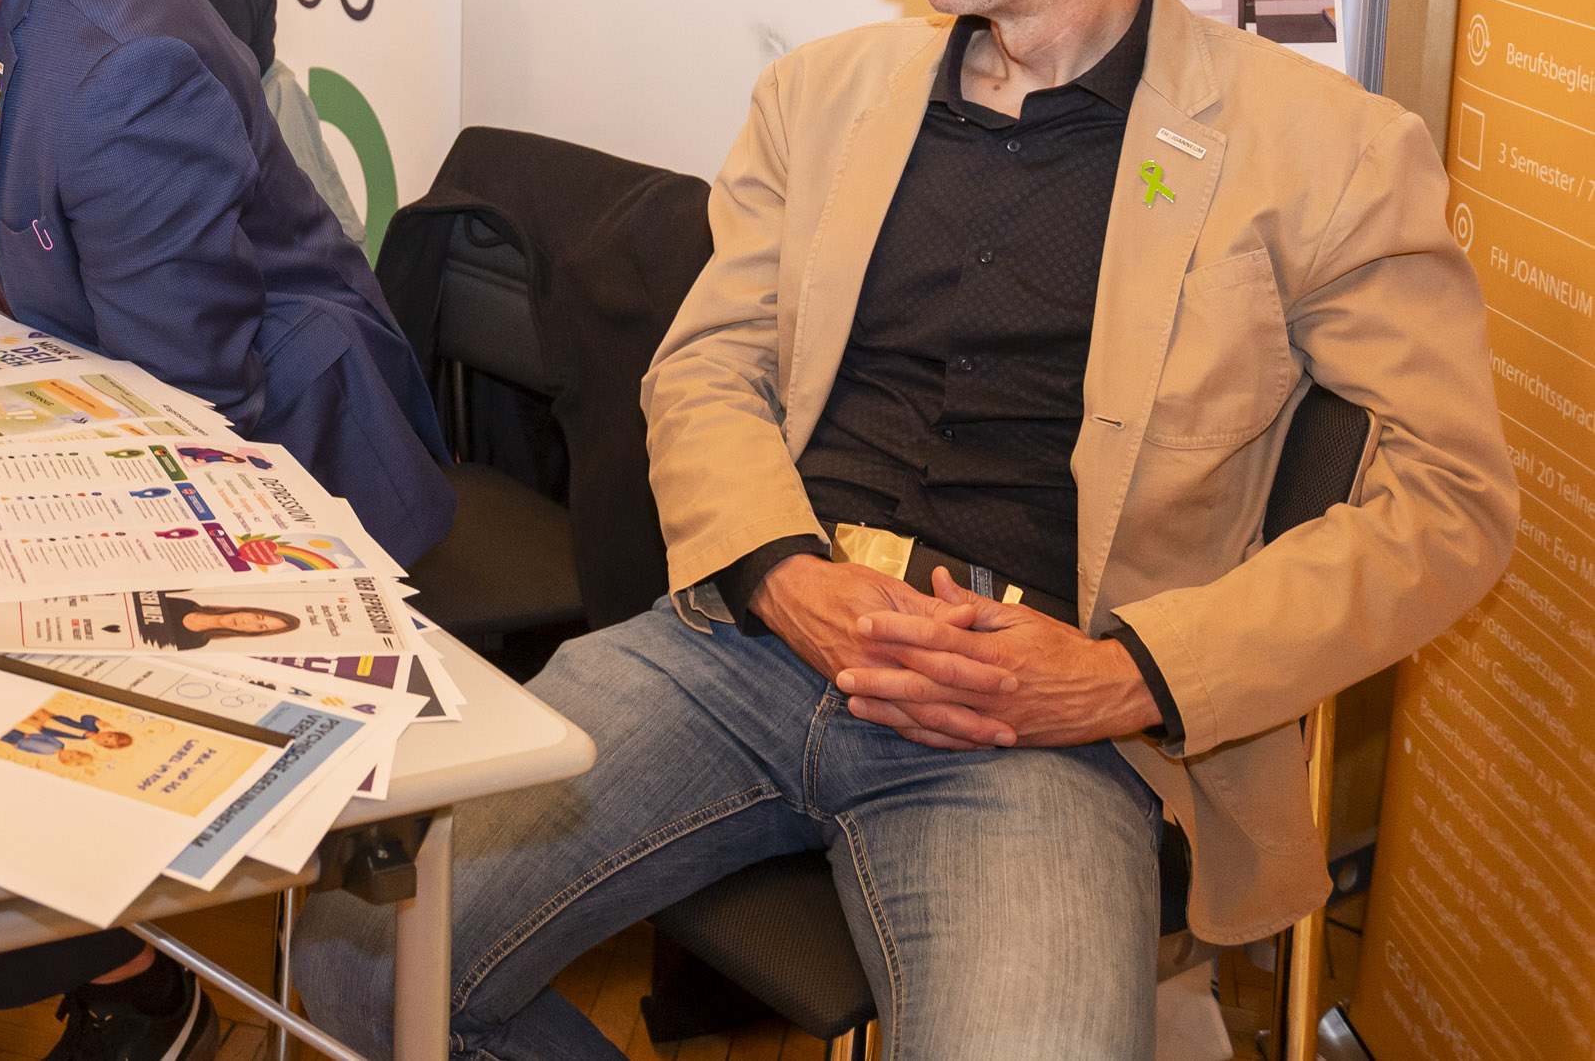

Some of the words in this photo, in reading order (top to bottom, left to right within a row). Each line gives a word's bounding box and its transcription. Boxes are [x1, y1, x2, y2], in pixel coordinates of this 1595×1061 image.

[1498, 141, 1507, 165] 3
[1508, 146, 1575, 195] Semester
[1489, 244, 1509, 275] FH
[1510, 256, 1593, 320] JOANNEUM
[257, 475, 315, 525] DEPRESSION
[1536, 460, 1555, 490] 20
[1553, 536, 1577, 573] Eva
[359, 592, 395, 636] DEPRESSION
[271, 717, 341, 775] PSYCHISCHE
[207, 771, 280, 835] GESUNDHEIT
[191, 832, 213, 849] IM
